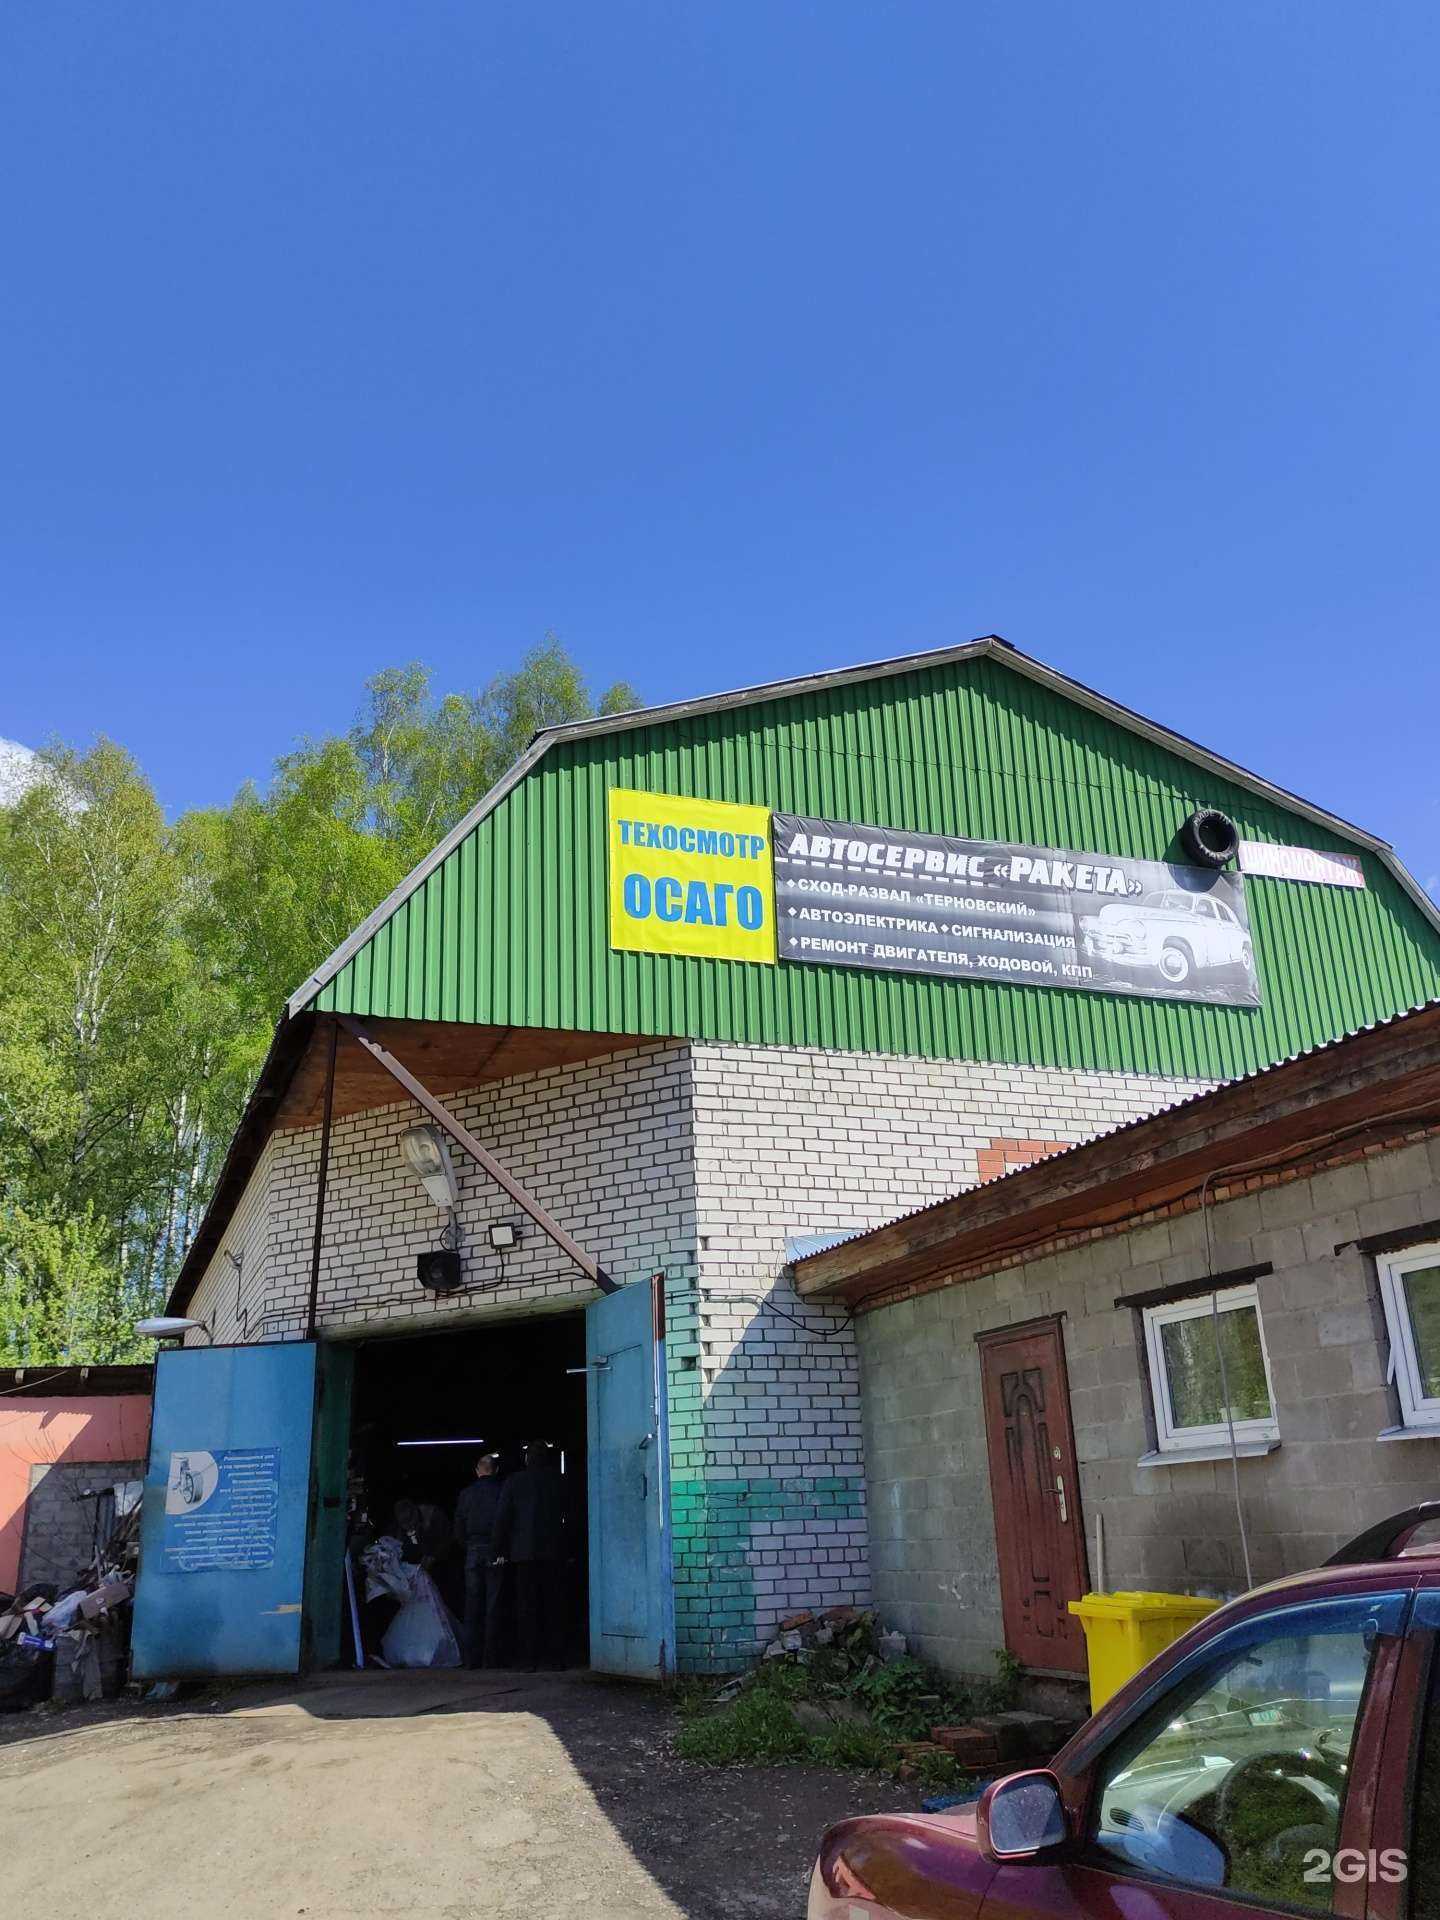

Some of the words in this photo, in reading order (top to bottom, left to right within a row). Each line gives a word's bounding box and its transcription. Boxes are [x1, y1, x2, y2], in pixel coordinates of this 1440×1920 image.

[618, 819, 765, 860] ТЕХОСМОТР
[788, 833, 986, 878] АВТОСЕРВИС
[993, 855, 1144, 896] «РАКЕТА»
[623, 873, 764, 930] ОСАГО
[798, 879, 911, 903] СХОД-РАЗВАЛ
[916, 893, 1036, 917] «ТЕРНОВСКИЙ»
[799, 907, 939, 934] АВТОЭЛЕКТРИКА
[951, 924, 1076, 949] СИГНАЛИЗАЦИЯ
[800, 936, 868, 955] РЕМОНТ
[873, 943, 973, 968] ДВИГАТЕЛЯ,
[977, 954, 1057, 976] ХОДОВОЙ,
[1061, 964, 1093, 979] КПП
